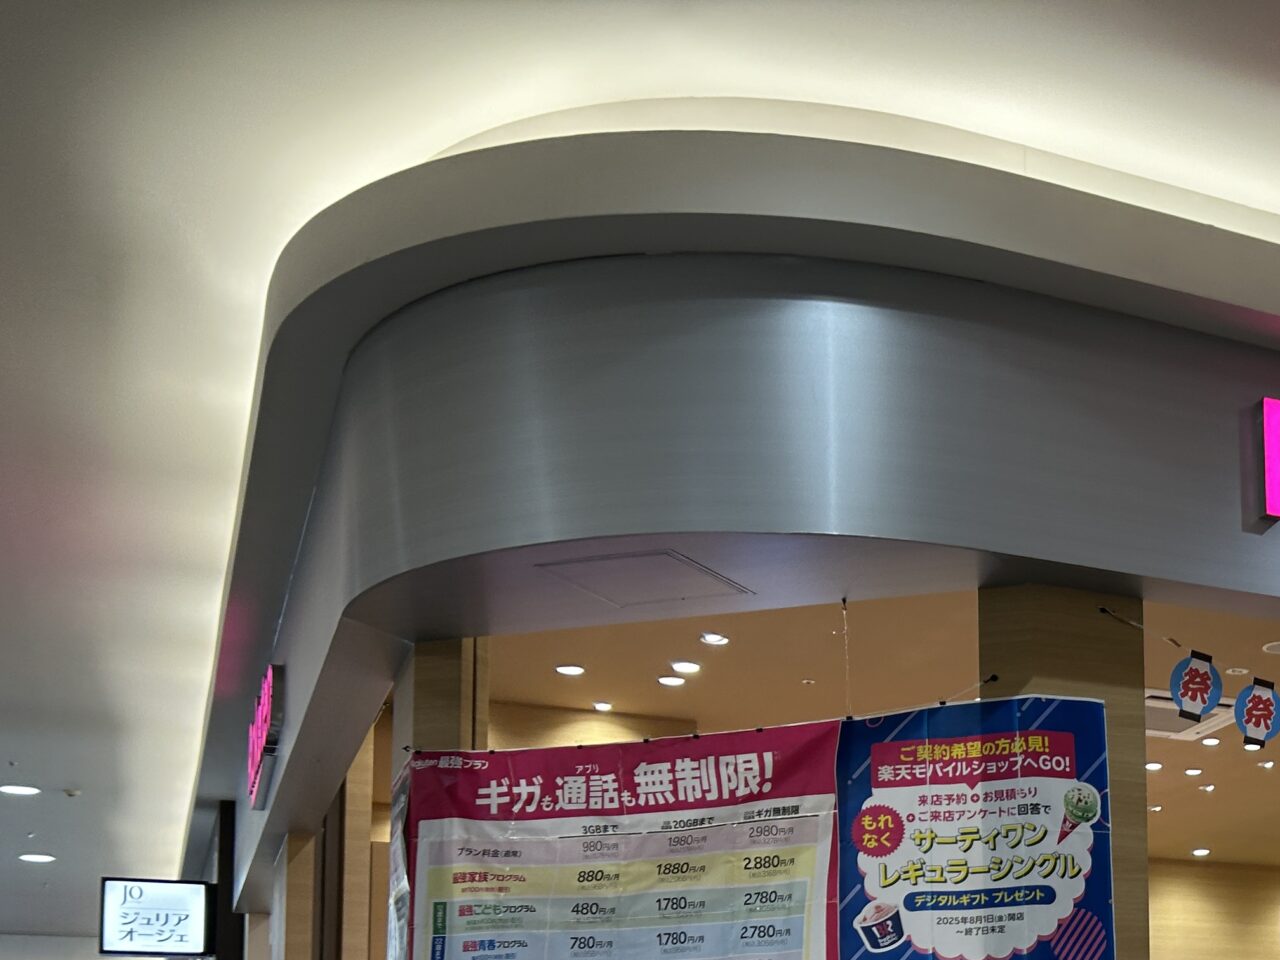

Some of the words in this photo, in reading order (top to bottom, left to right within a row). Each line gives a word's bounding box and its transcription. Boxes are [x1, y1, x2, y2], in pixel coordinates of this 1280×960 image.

[1180, 667, 1212, 705] 祭
[1244, 694, 1275, 730] 祭
[900, 736, 1049, 761] ご契約希望の方必見!
[438, 756, 488, 770] 最強プラン
[575, 765, 599, 774] アプリ
[878, 755, 1070, 782] 楽天モバイルショップへGO!
[475, 751, 773, 814] ギガも通話も無制限!
[918, 794, 967, 806] 来店予約
[756, 805, 800, 818] ギガ無制限
[919, 803, 1051, 822] ご来店アンケートに回答で
[582, 825, 618, 834] 3GBまで
[673, 817, 714, 829] 20GBまで
[861, 815, 894, 829] もれ
[862, 834, 891, 848] なく
[911, 822, 1047, 854] サーティワン
[879, 851, 1082, 888] レギュラーシングル
[121, 885, 143, 905] JO
[914, 894, 989, 907] デジタルギフト
[992, 890, 1045, 903] プレゼント
[120, 912, 189, 927] ジュリア
[119, 928, 189, 942] オージェ
